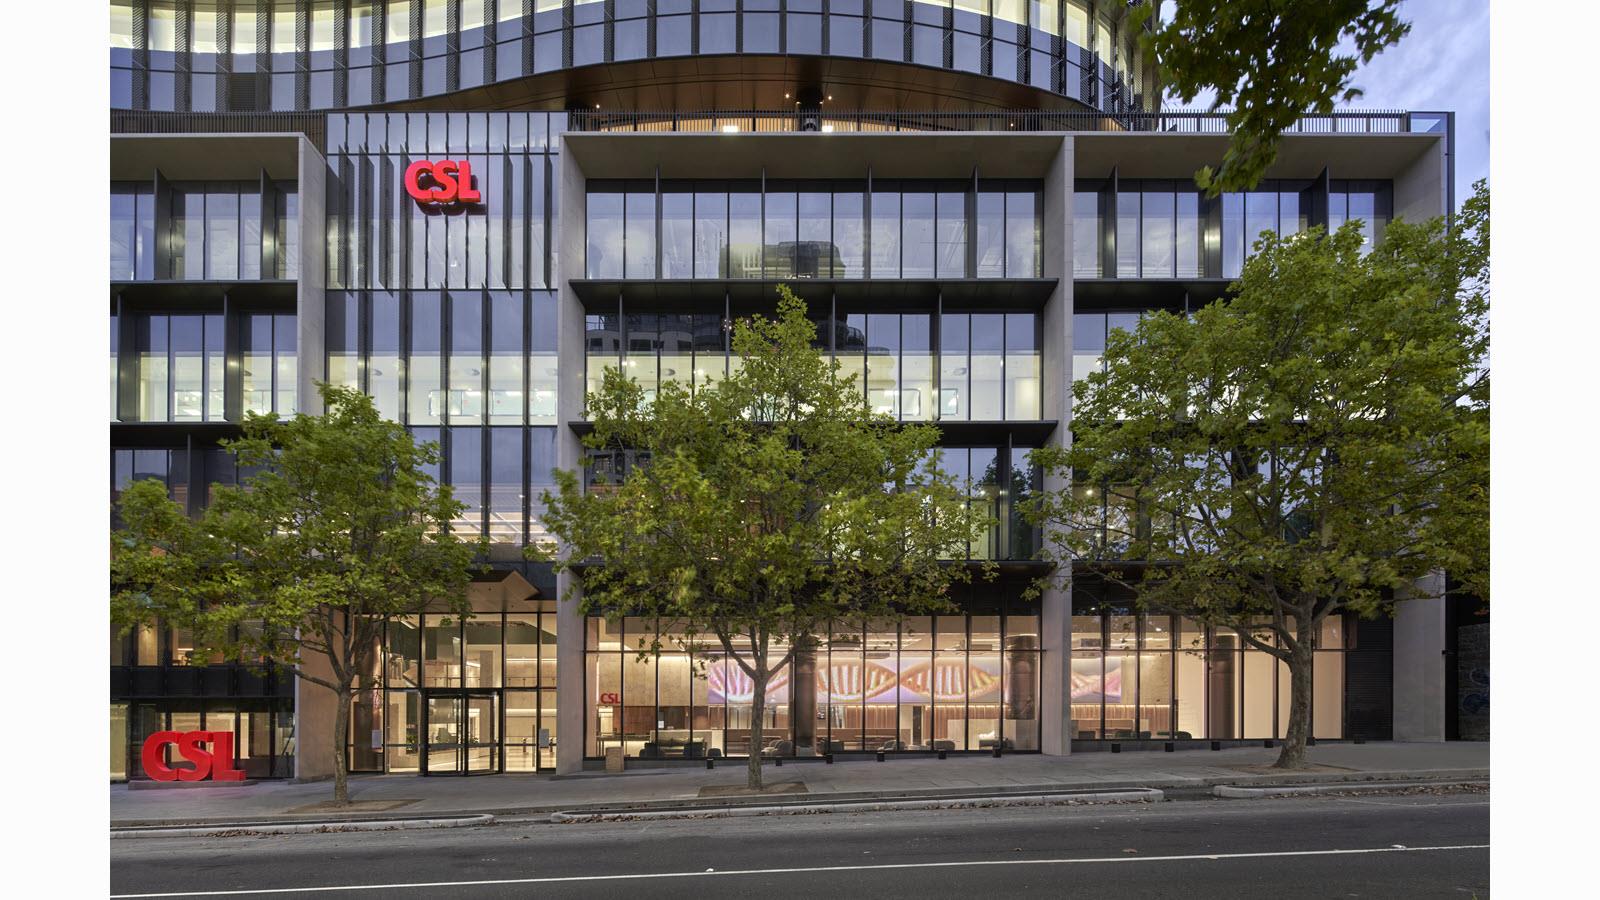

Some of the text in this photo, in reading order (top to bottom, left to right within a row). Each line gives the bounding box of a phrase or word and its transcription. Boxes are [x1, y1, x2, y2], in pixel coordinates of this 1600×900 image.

[404, 160, 481, 203] CSL
[600, 692, 621, 704] CSL
[142, 731, 246, 782] CSL
